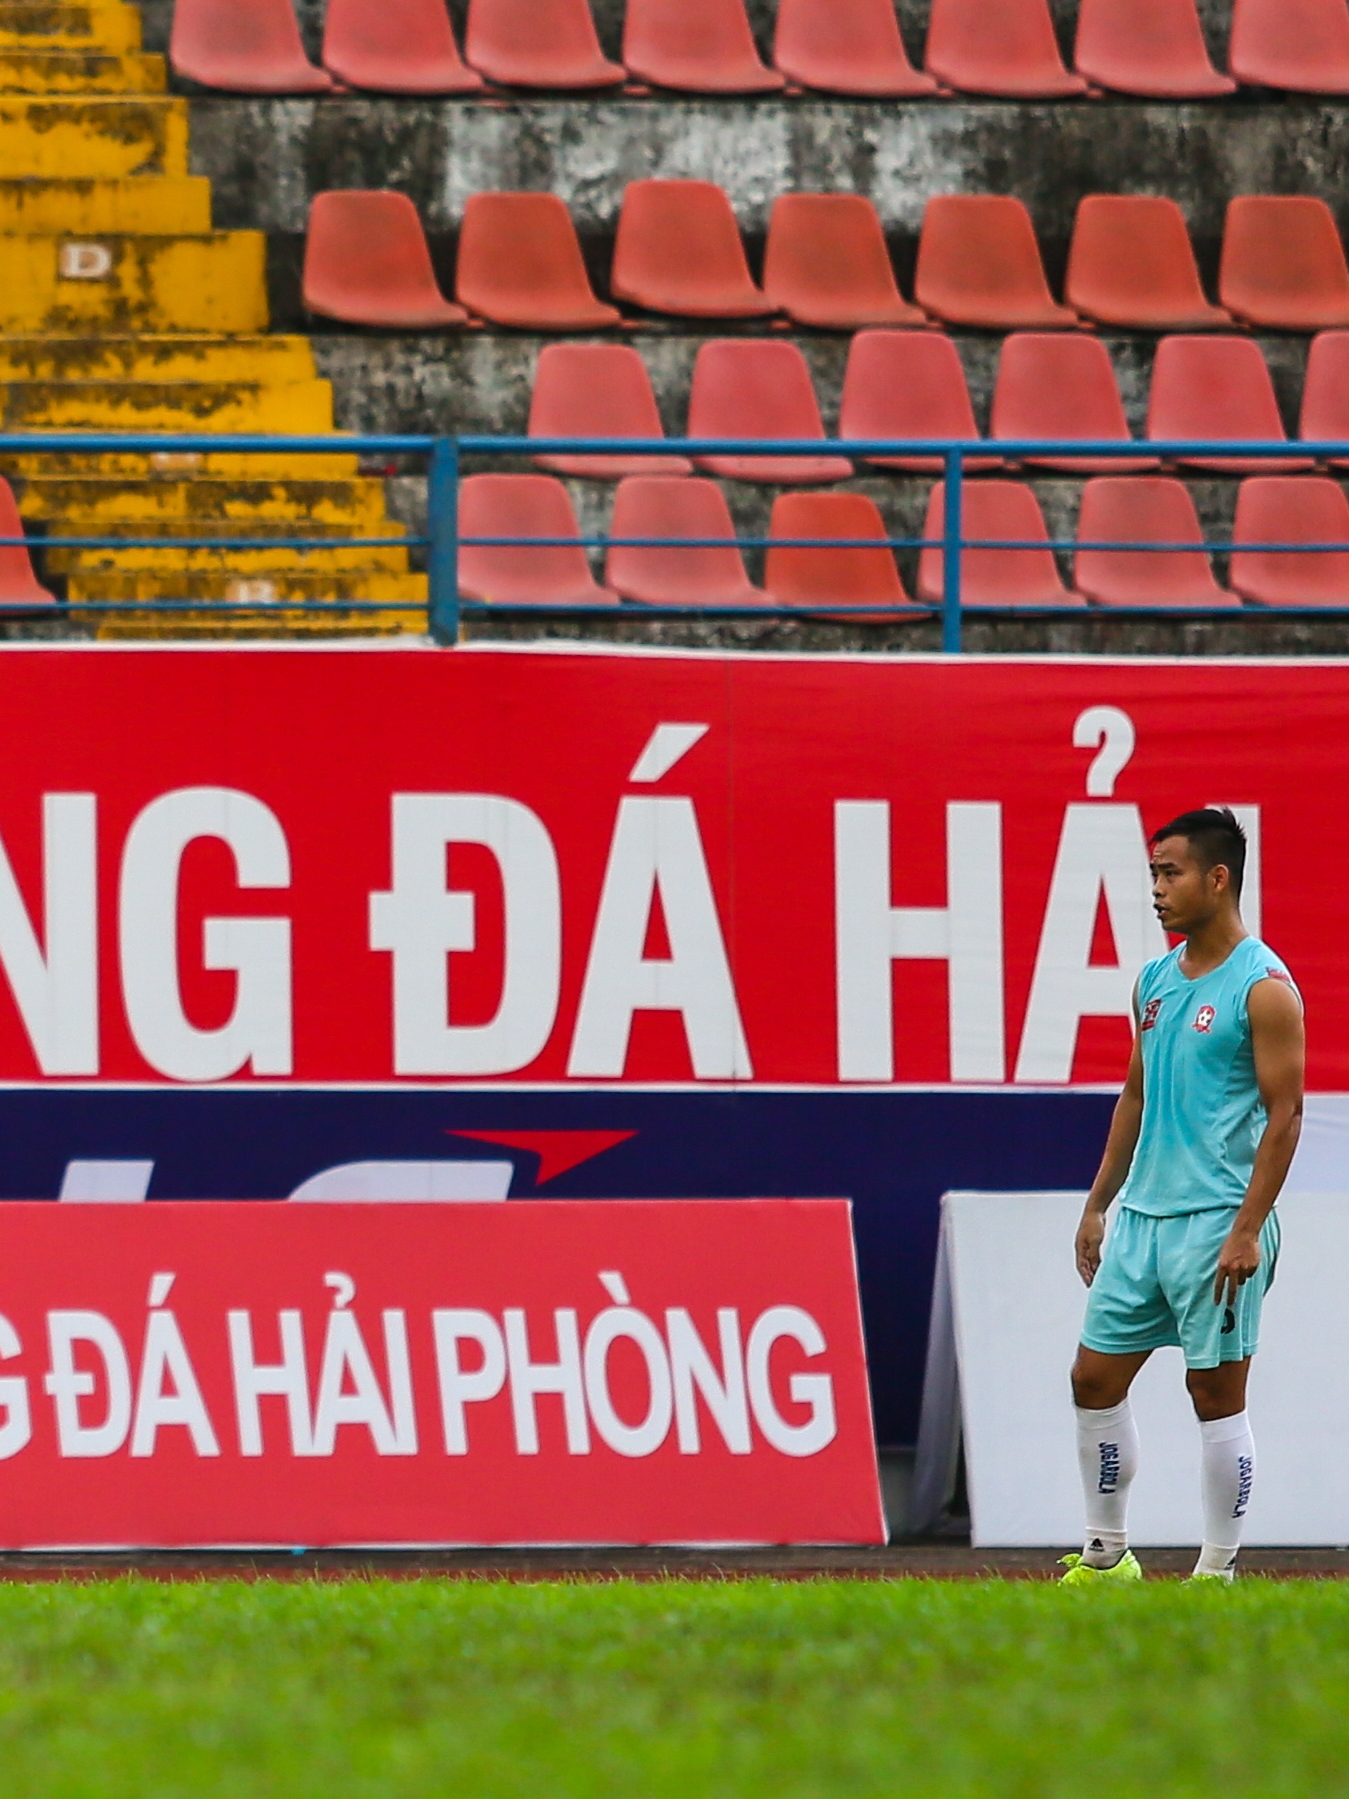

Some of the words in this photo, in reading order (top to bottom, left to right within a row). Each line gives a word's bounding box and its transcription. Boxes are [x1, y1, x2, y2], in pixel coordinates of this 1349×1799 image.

[66, 244, 111, 278] D
[369, 722, 753, 1079] ĐÁ
[44, 1272, 221, 1458] ĐÁ
[226, 1271, 419, 1458] HẢI
[431, 1270, 837, 1458] PHÒNG
[1231, 1455, 1254, 1519] JOGARBOLA
